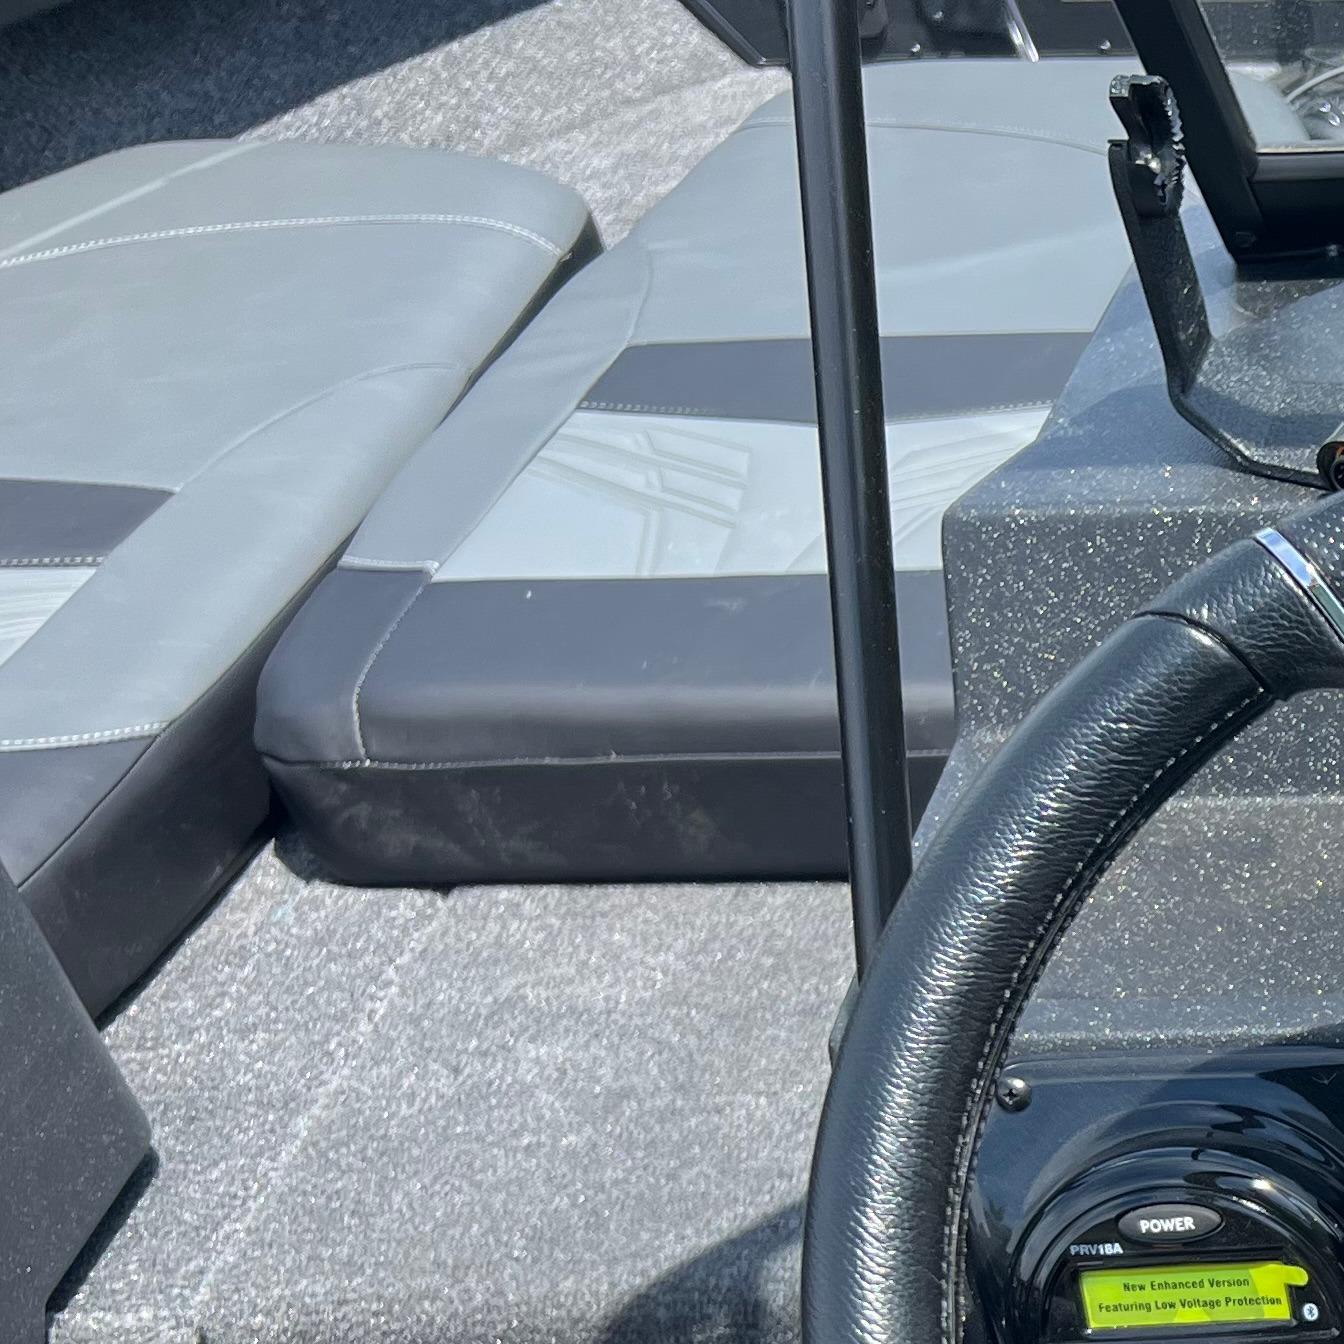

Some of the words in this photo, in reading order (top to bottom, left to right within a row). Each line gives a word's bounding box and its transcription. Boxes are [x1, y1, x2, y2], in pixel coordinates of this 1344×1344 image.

[1140, 1216, 1196, 1234] POWER
[1123, 1282, 1146, 1292] New
[1151, 1278, 1204, 1290] Enhanced
[1208, 1277, 1250, 1288] Version
[1098, 1301, 1151, 1312] Featuring
[1155, 1299, 1176, 1309] Low
[1180, 1297, 1222, 1309] Voltage
[1225, 1295, 1282, 1306] Protection
